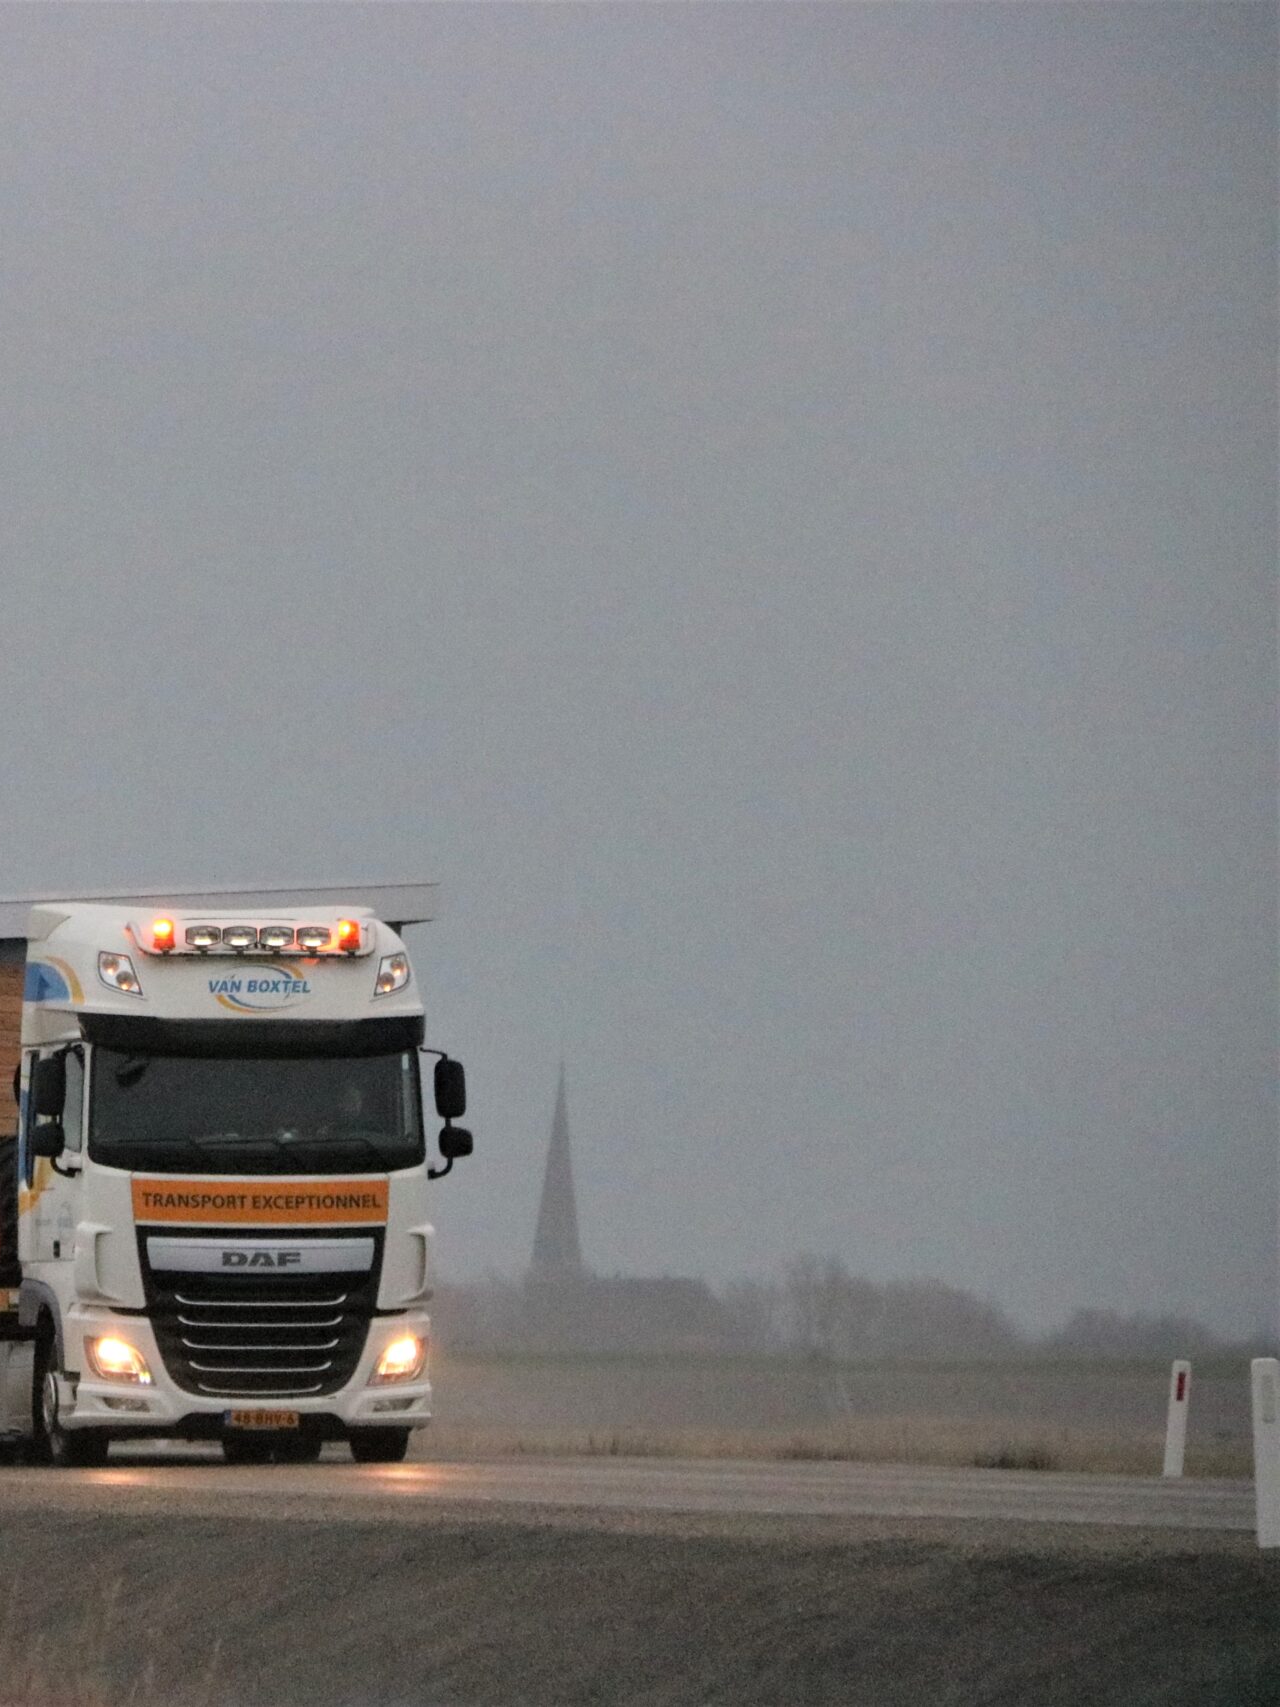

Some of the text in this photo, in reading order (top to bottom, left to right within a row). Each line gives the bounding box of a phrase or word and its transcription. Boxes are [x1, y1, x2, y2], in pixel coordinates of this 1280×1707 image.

[208, 979, 311, 994] VAN BOXTEL
[142, 1191, 382, 1210] TRANSPORT EXCEPTIONNEL
[222, 1252, 301, 1267] DAF
